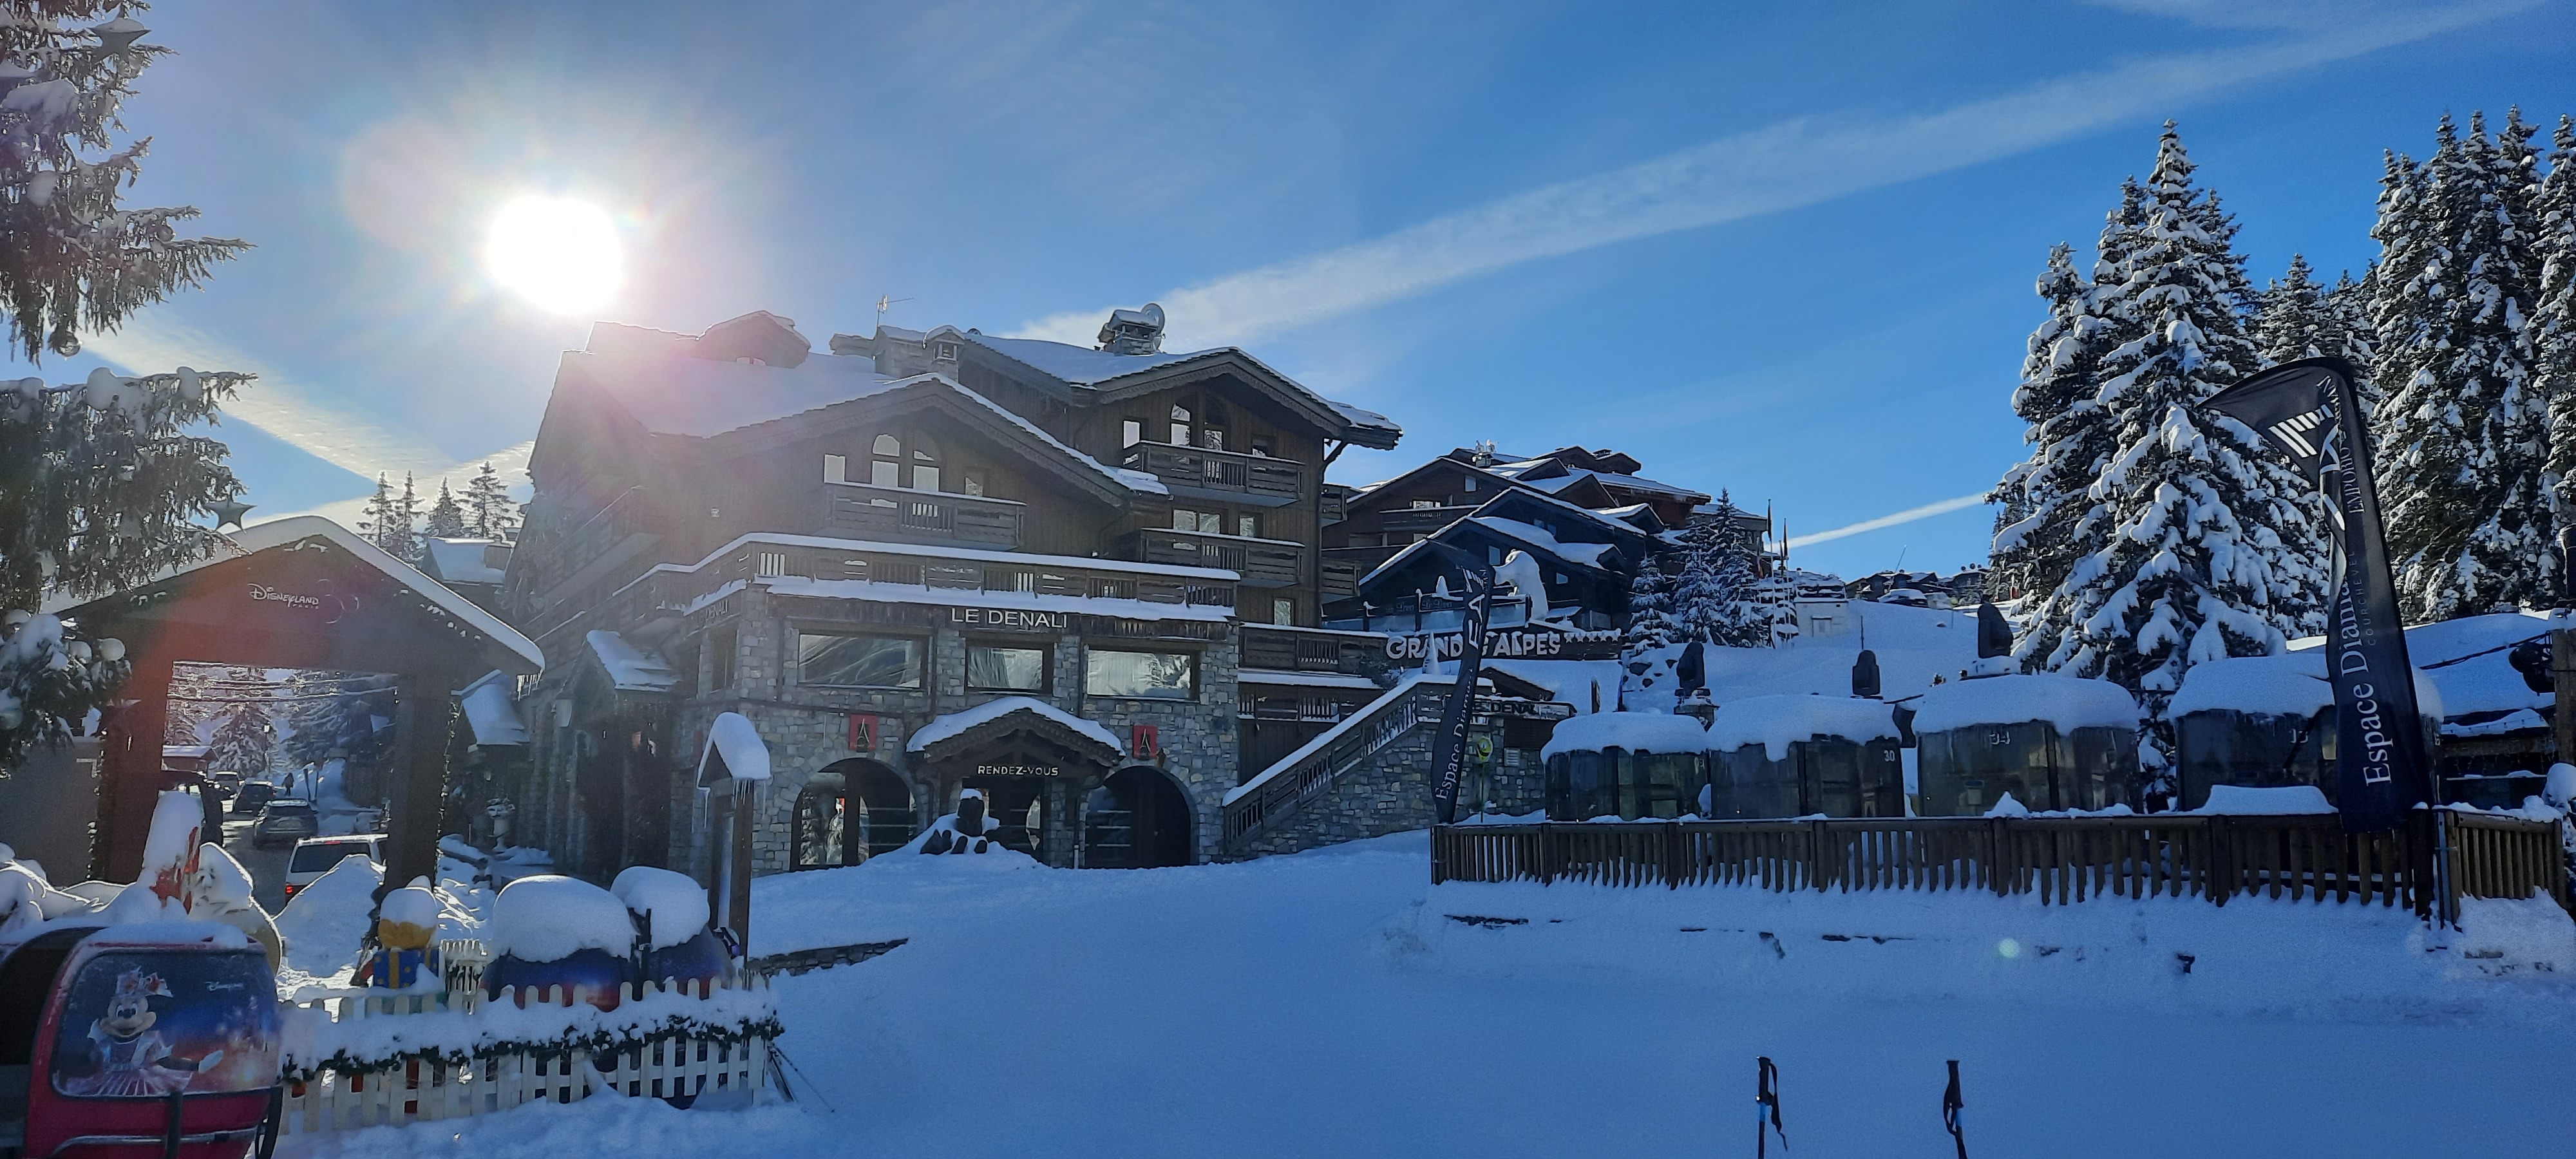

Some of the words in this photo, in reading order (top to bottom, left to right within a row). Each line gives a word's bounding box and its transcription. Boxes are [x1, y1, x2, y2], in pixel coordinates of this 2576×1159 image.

[2349, 551, 2376, 646] COURCHEVEL
[951, 607, 980, 623] LE
[988, 610, 1067, 628] DENALI
[1492, 632, 1561, 657] ALPES
[2353, 683, 2394, 787] Espace
[1884, 749, 1895, 762] 30
[978, 765, 1059, 776] RENDEZ-VOUS
[1435, 743, 1461, 800] Espace
